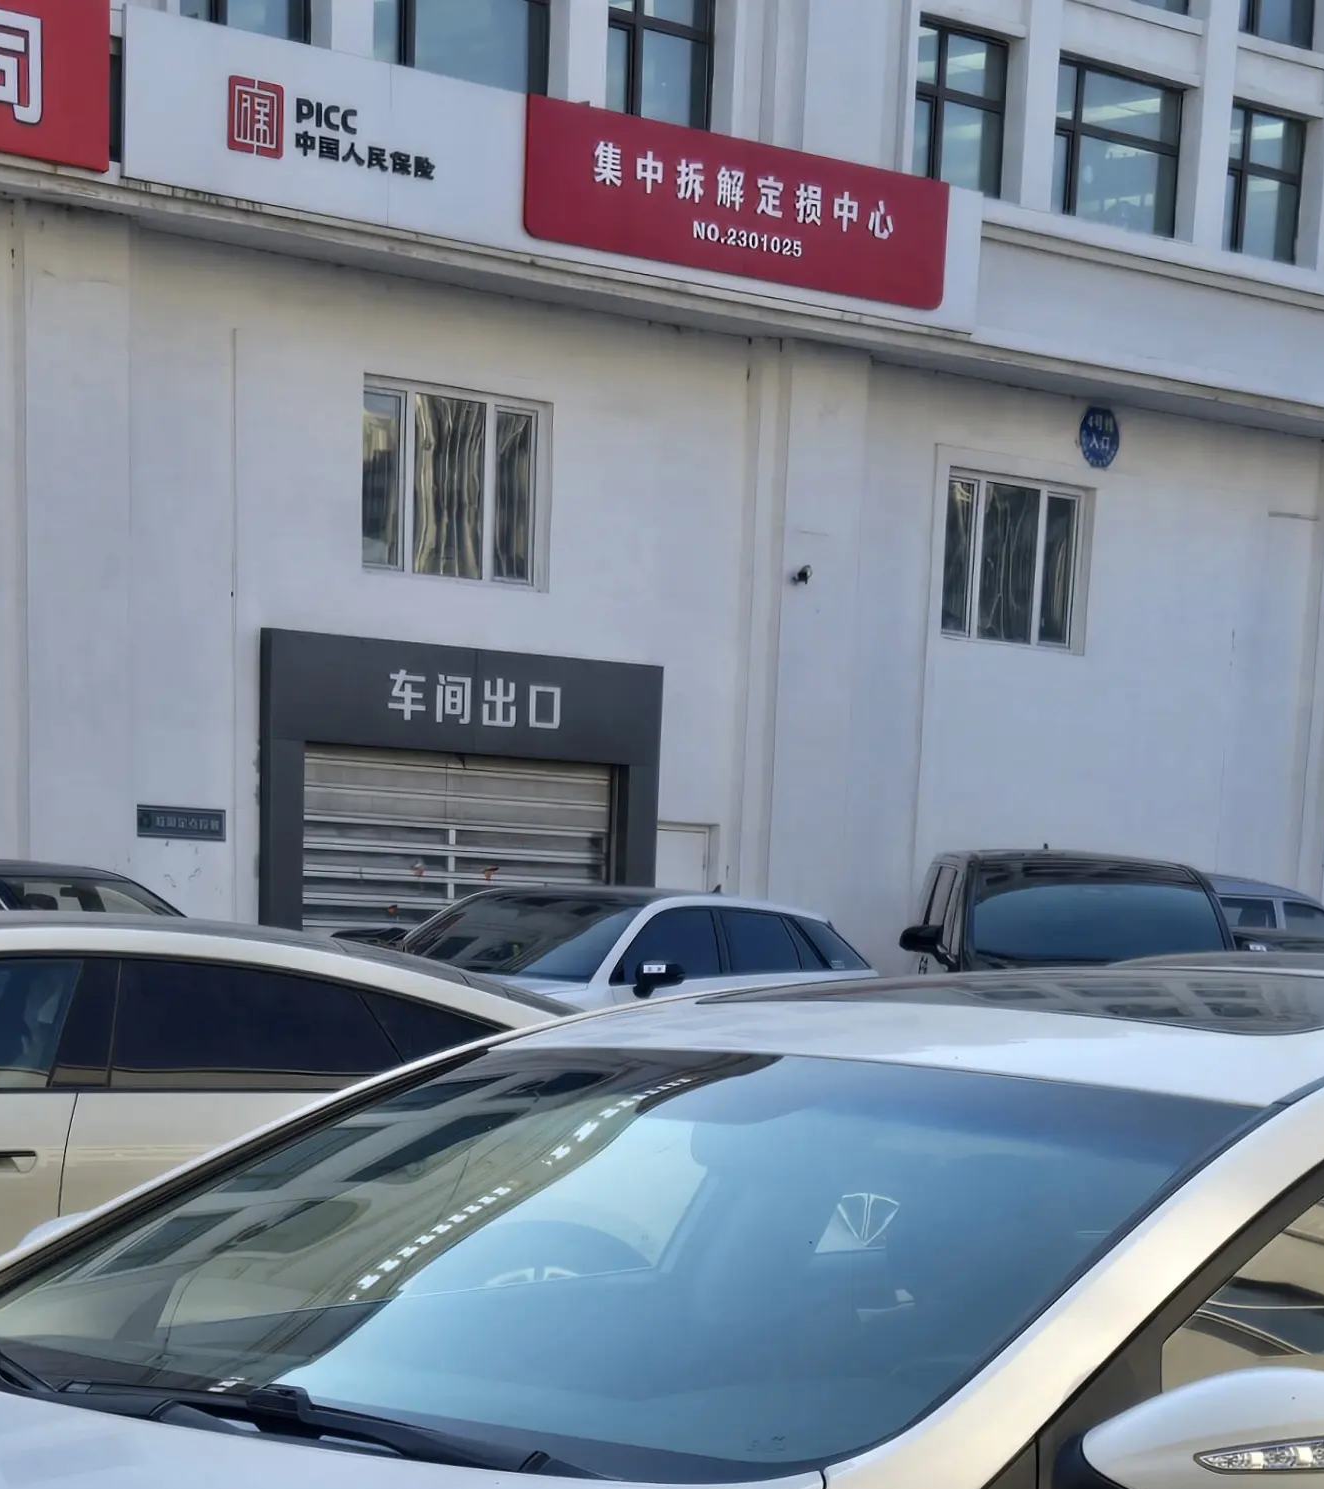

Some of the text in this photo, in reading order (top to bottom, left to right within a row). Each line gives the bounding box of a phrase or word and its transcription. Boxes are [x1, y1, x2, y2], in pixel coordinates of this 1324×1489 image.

[295, 97, 358, 135] PICC
[294, 131, 436, 180] 中国人民保险
[593, 140, 894, 240] 集中拆解定损中心
[692, 220, 803, 258] NO.2301025
[388, 669, 562, 730] 车间出口
